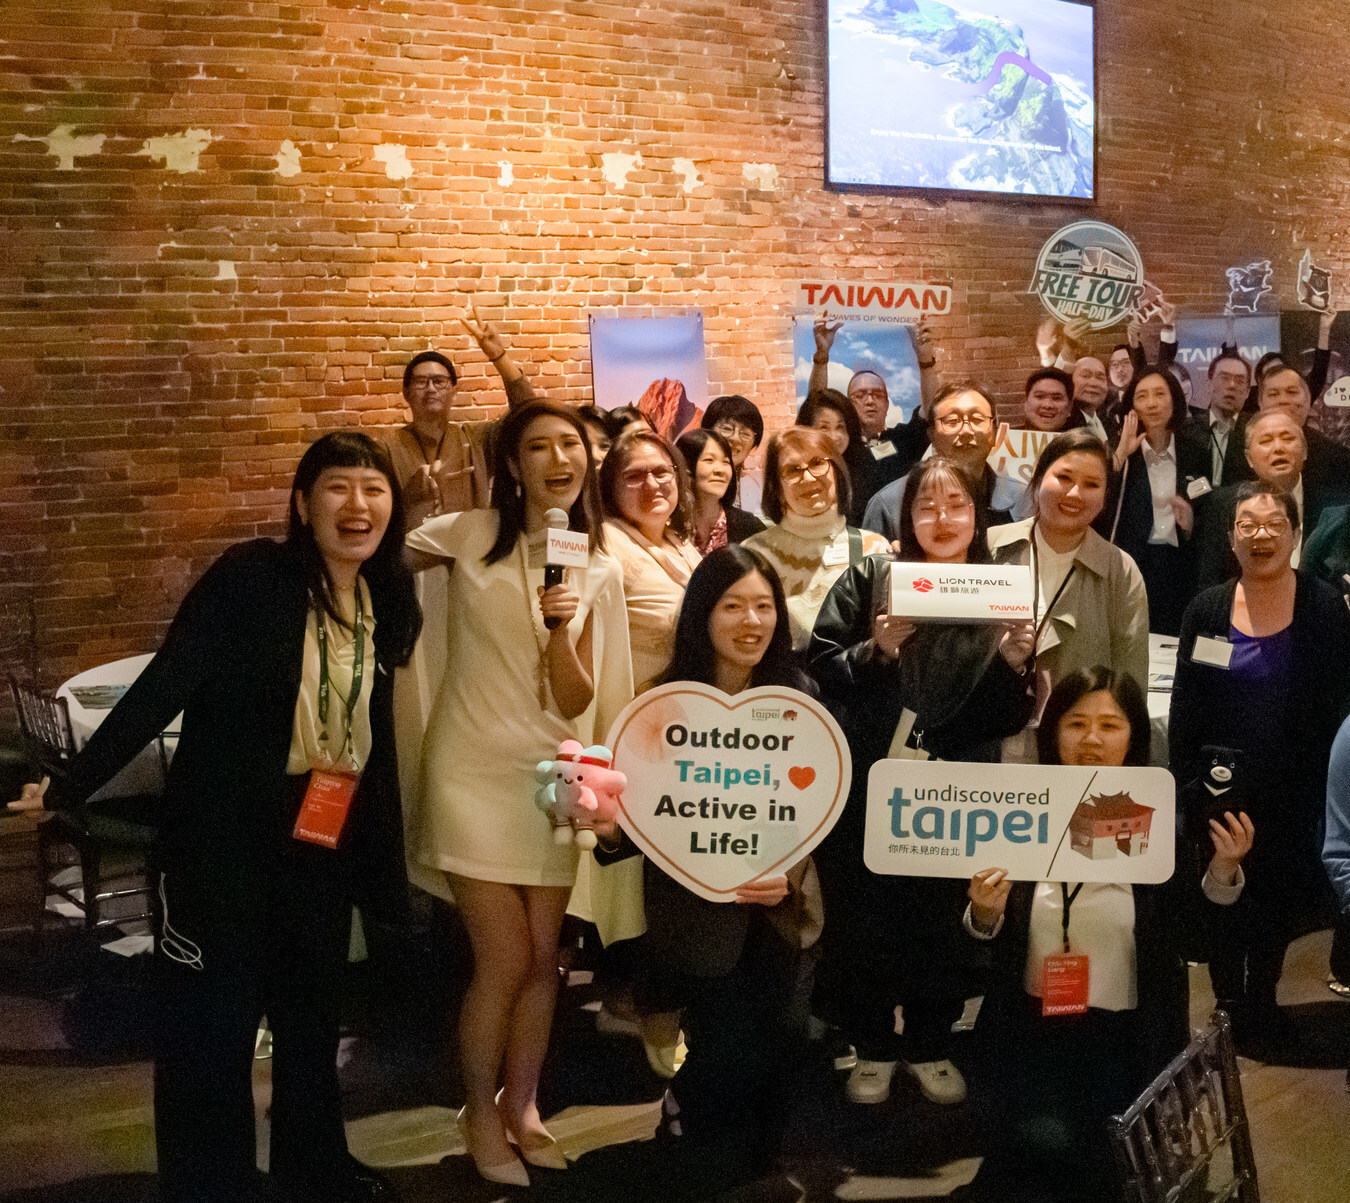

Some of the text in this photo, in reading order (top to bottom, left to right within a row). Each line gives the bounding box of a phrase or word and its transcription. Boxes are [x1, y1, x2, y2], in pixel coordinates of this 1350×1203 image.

[800, 283, 948, 311] TAIWAN
[1029, 269, 1145, 310] FREE TOUR
[878, 316, 918, 324] WONDER
[1056, 300, 1114, 321] HALF-DAY
[550, 538, 588, 553] TAIWAN
[939, 577, 1012, 587] LION TRAVEL
[988, 604, 1030, 612] TAIWAN
[665, 723, 795, 752] Outdoor
[674, 760, 781, 791] Taipei,
[914, 784, 1050, 805] undiscovered
[654, 794, 796, 822] Active in
[887, 786, 1049, 857] taipei
[689, 831, 759, 856] Life!
[888, 844, 961, 857] 你所未見的台北
[1046, 1004, 1085, 1013] TAIWAN
